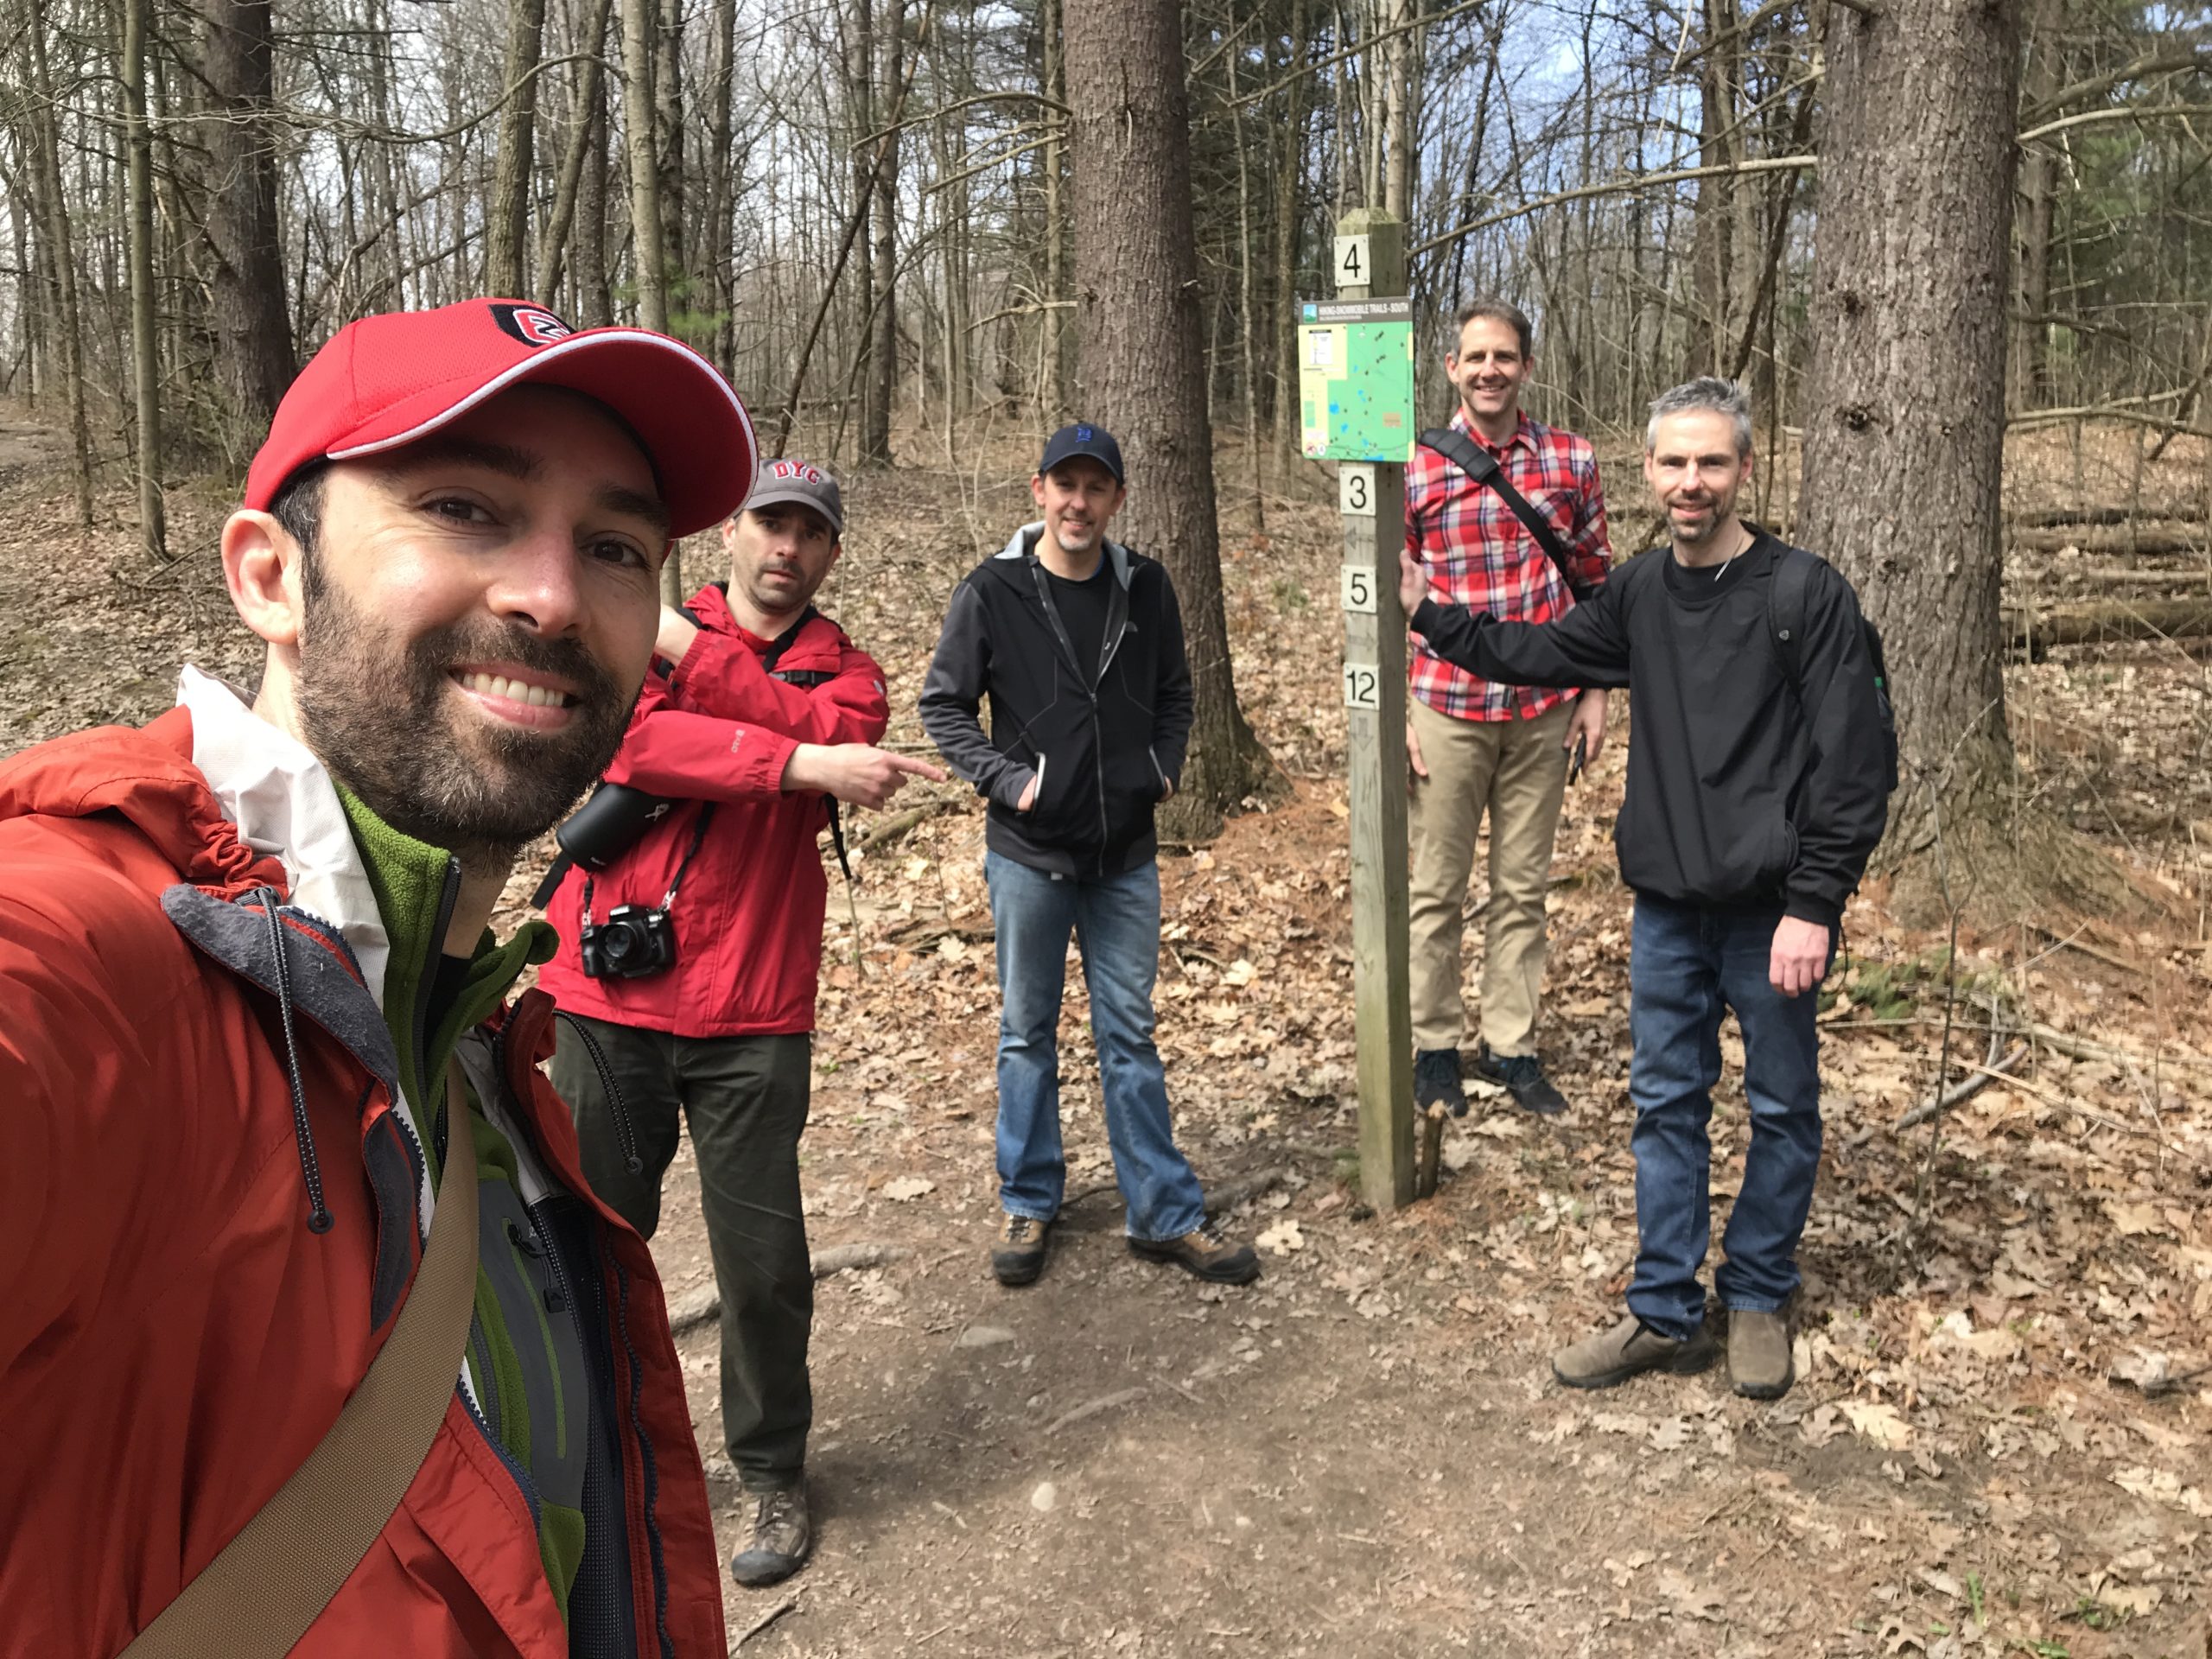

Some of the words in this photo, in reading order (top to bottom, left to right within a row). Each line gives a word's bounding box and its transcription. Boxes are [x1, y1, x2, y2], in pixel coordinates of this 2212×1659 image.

[1344, 243, 1361, 278] 4
[1350, 475, 1367, 510] 3
[1351, 573, 1368, 606] 5
[1346, 670, 1376, 703] 12
